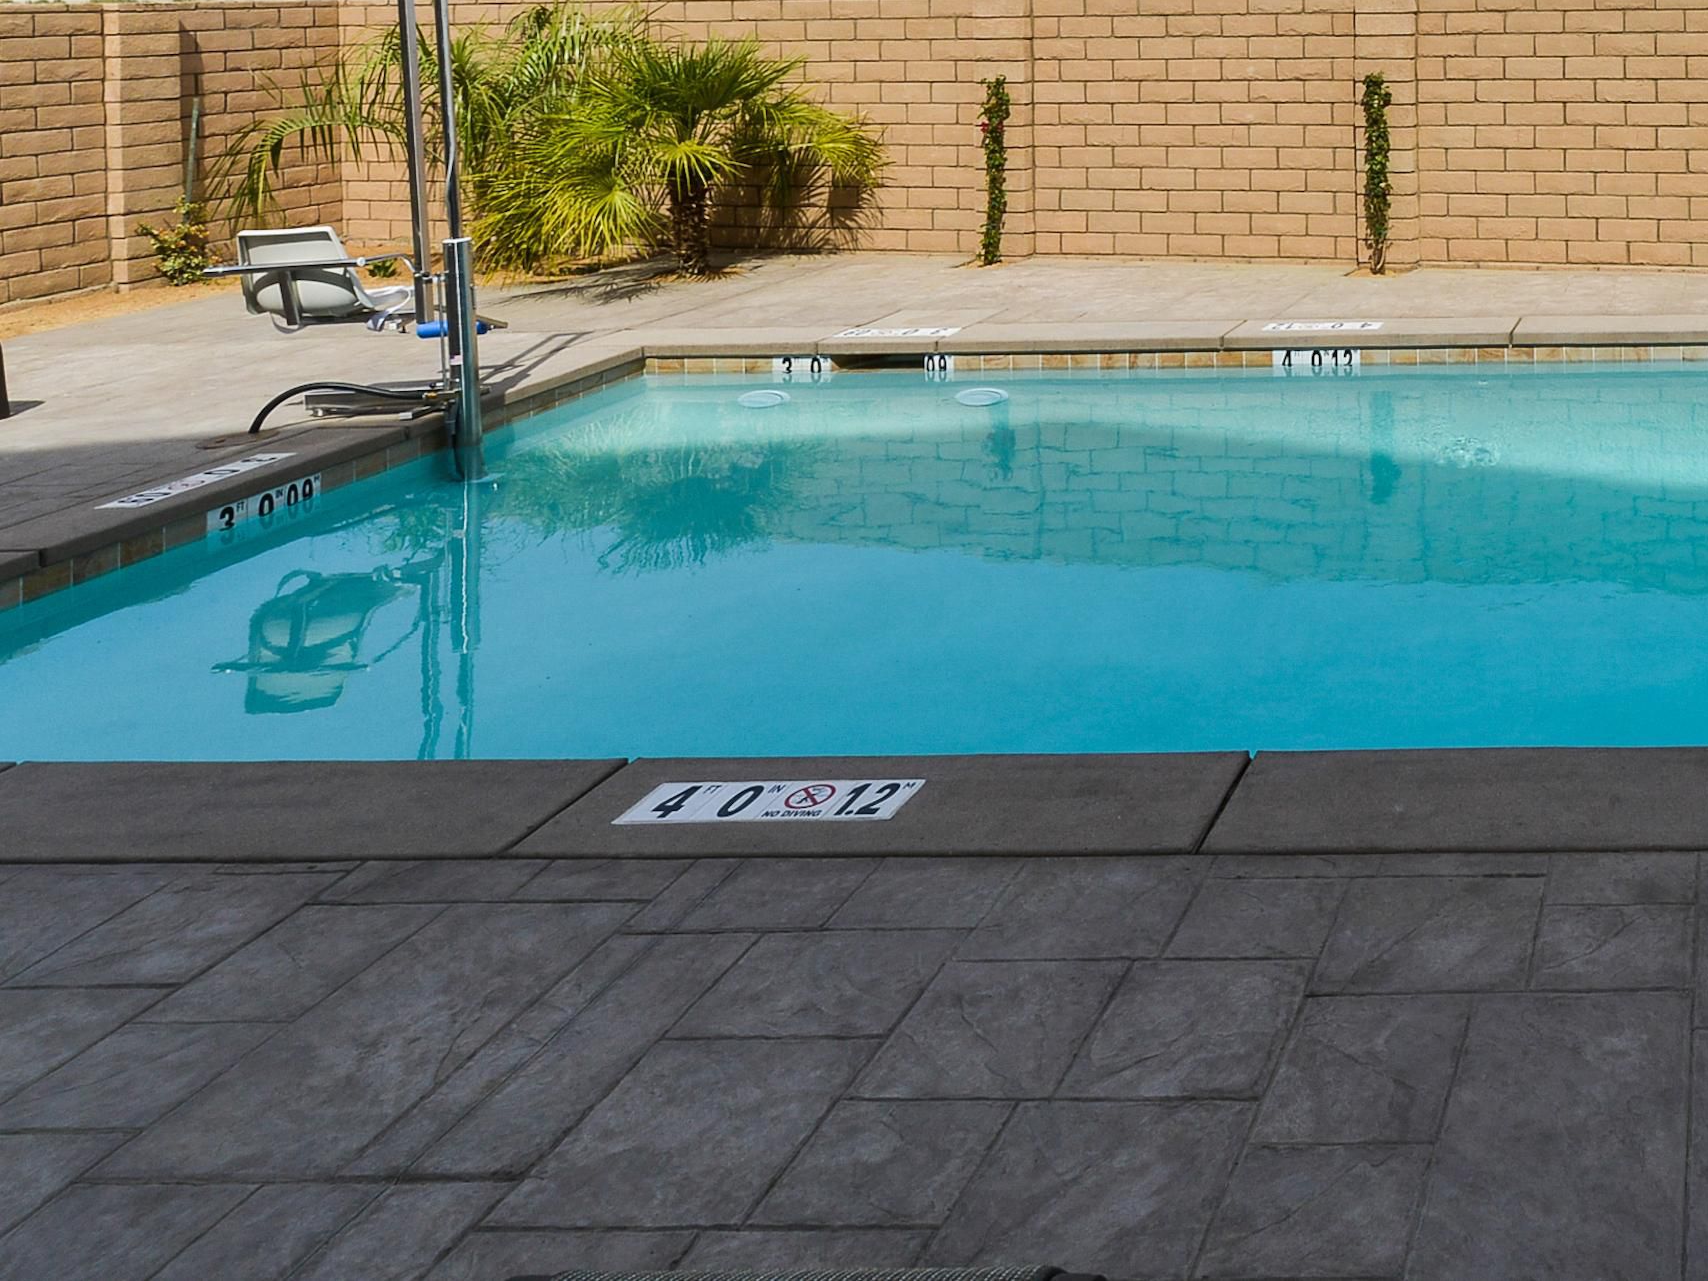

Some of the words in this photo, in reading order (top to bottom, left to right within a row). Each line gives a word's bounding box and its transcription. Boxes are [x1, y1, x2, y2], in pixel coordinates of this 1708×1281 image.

[782, 356, 793, 373] 3
[1282, 349, 1292, 367] 4
[219, 506, 235, 531] 3
[236, 502, 245, 511] FT
[258, 493, 275, 517] 0
[275, 489, 284, 498] IN
[652, 785, 702, 819] 4
[704, 785, 722, 794] FT
[717, 784, 765, 818] 0
[768, 784, 786, 794] IN
[833, 782, 902, 816] 1.2
[903, 782, 916, 790] M
[761, 810, 780, 818] NO
[781, 809, 822, 818] DIVING
